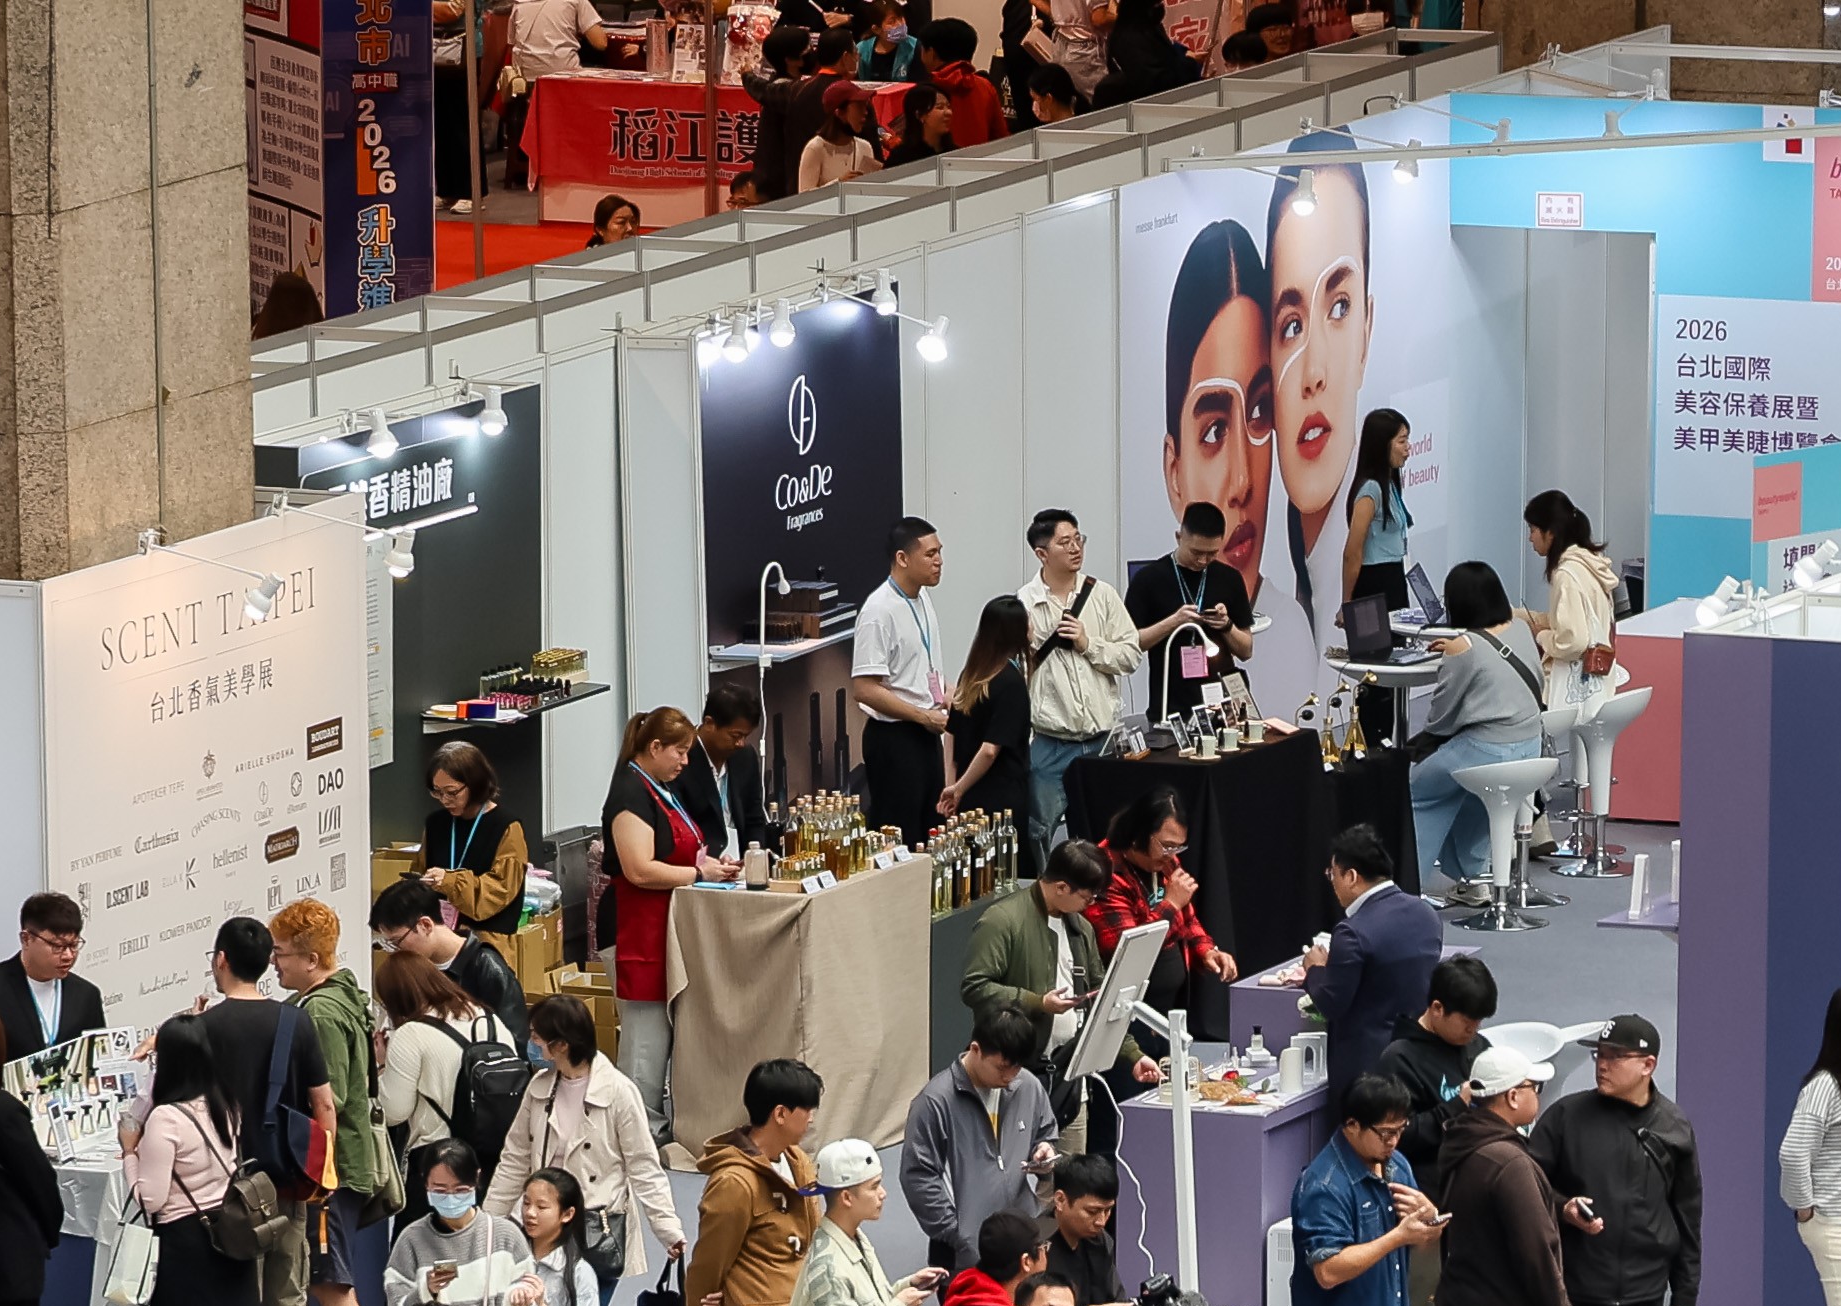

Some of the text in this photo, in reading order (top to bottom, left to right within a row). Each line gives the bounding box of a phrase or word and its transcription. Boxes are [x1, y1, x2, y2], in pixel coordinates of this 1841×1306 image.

[352, 71, 399, 92] 高中職
[357, 98, 398, 196] 2026
[609, 106, 762, 166] 稻江護
[1675, 318, 1728, 342] 2026
[1676, 352, 1772, 382] 台北國際
[1674, 389, 1820, 421] 美容保養展暨
[328, 457, 454, 520] 香精油廠
[1409, 464, 1440, 488] beauty
[786, 507, 824, 532] Fragrances
[100, 600, 203, 671] SCENT
[150, 657, 274, 724] 台北香氣美學展
[234, 756, 265, 774] ARIELLE
[317, 767, 344, 796] DAO
[212, 844, 249, 870] hellenist
[135, 879, 150, 901] LAB
